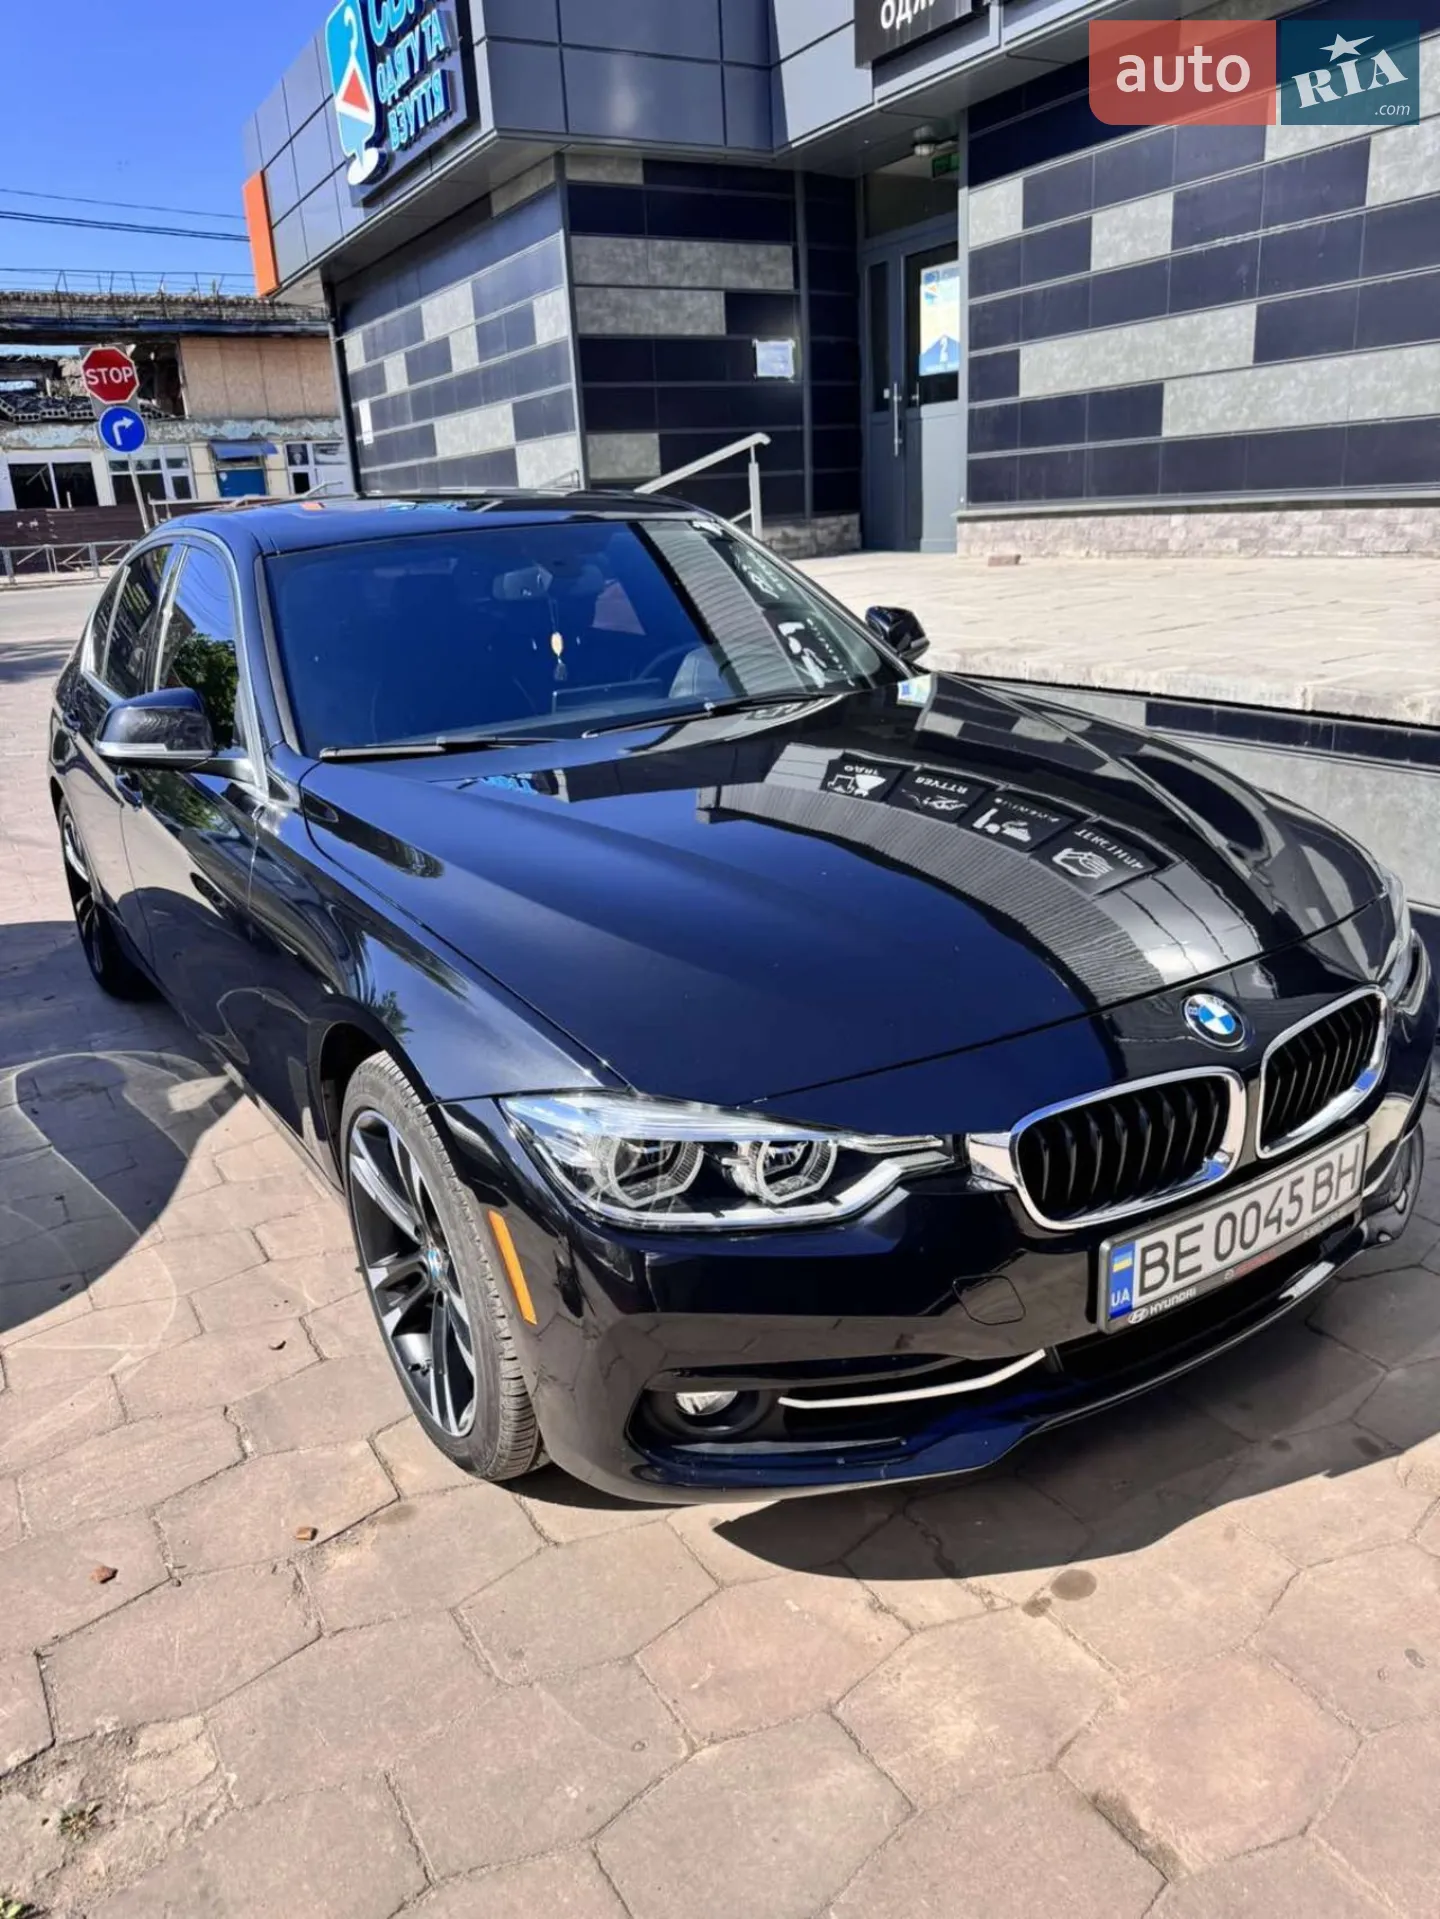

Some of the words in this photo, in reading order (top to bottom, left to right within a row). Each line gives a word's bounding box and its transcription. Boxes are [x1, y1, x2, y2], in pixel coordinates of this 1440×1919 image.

[85, 367, 133, 385] STOP
[1139, 1222, 1204, 1297] BE
[1214, 1176, 1304, 1262] 0045
[1311, 1144, 1360, 1214] BH
[1110, 1287, 1132, 1308] UA
